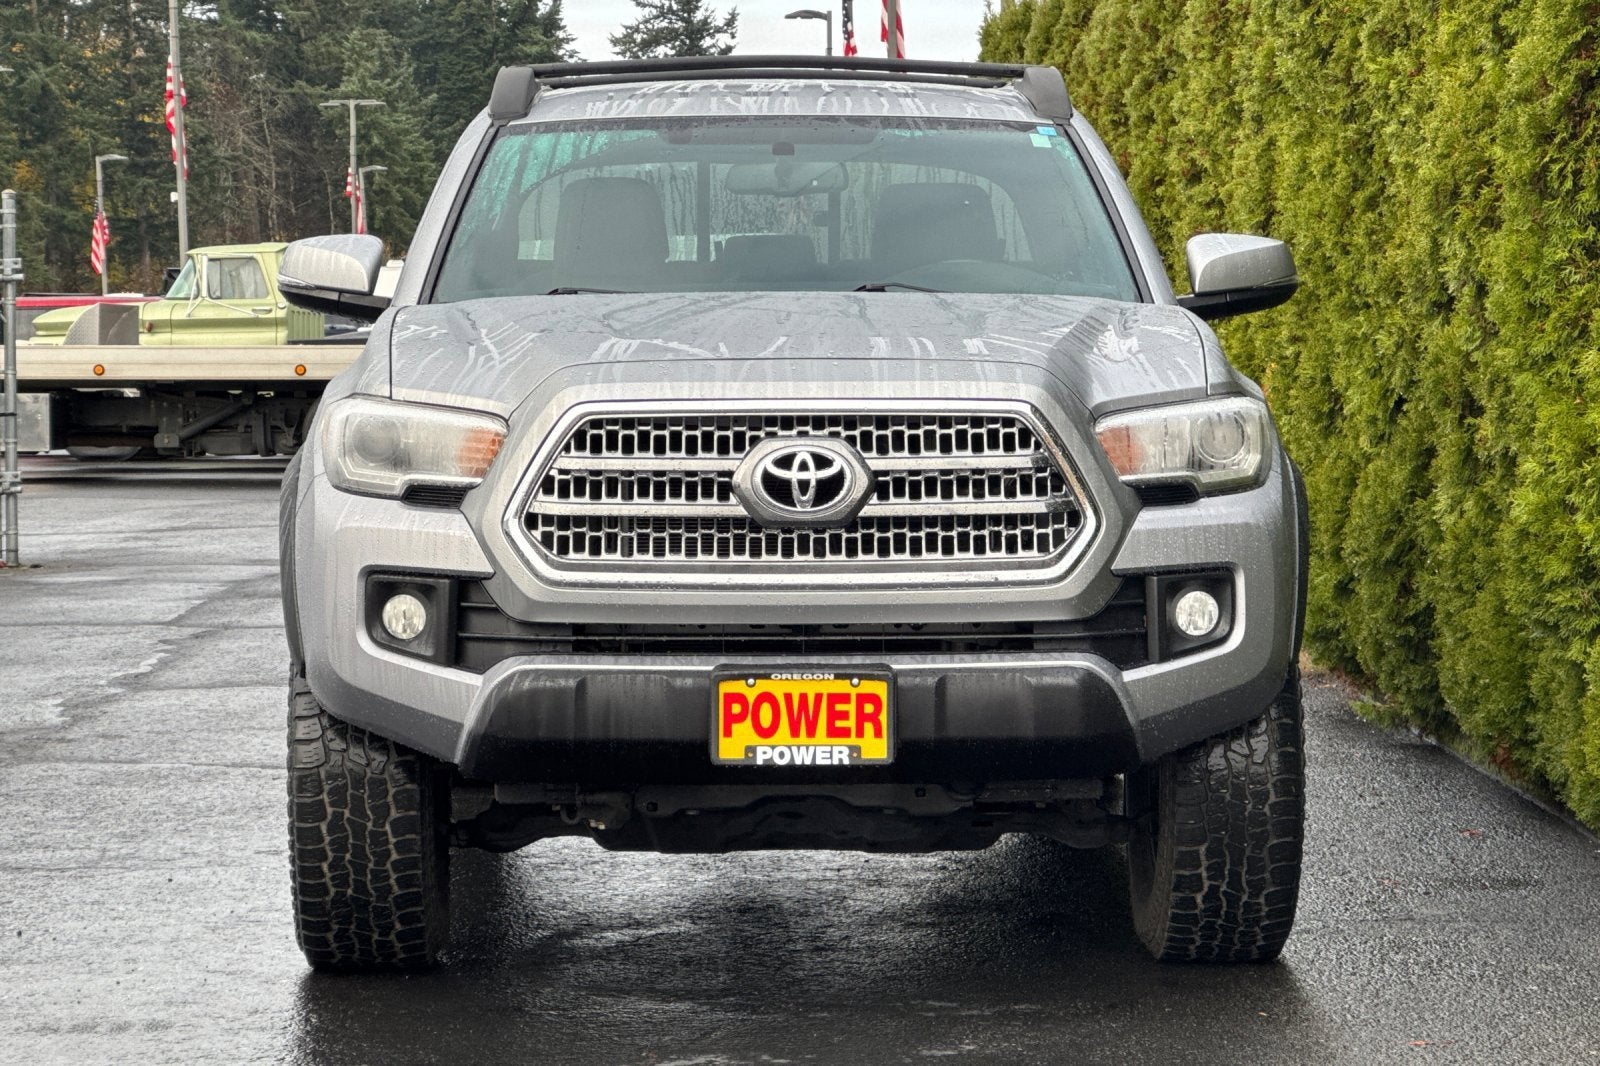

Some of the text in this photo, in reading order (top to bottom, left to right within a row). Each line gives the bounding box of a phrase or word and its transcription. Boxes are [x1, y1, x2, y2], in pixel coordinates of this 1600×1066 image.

[770, 673, 835, 681] OREGON
[722, 691, 883, 739] POWER
[755, 745, 850, 765] POWER
